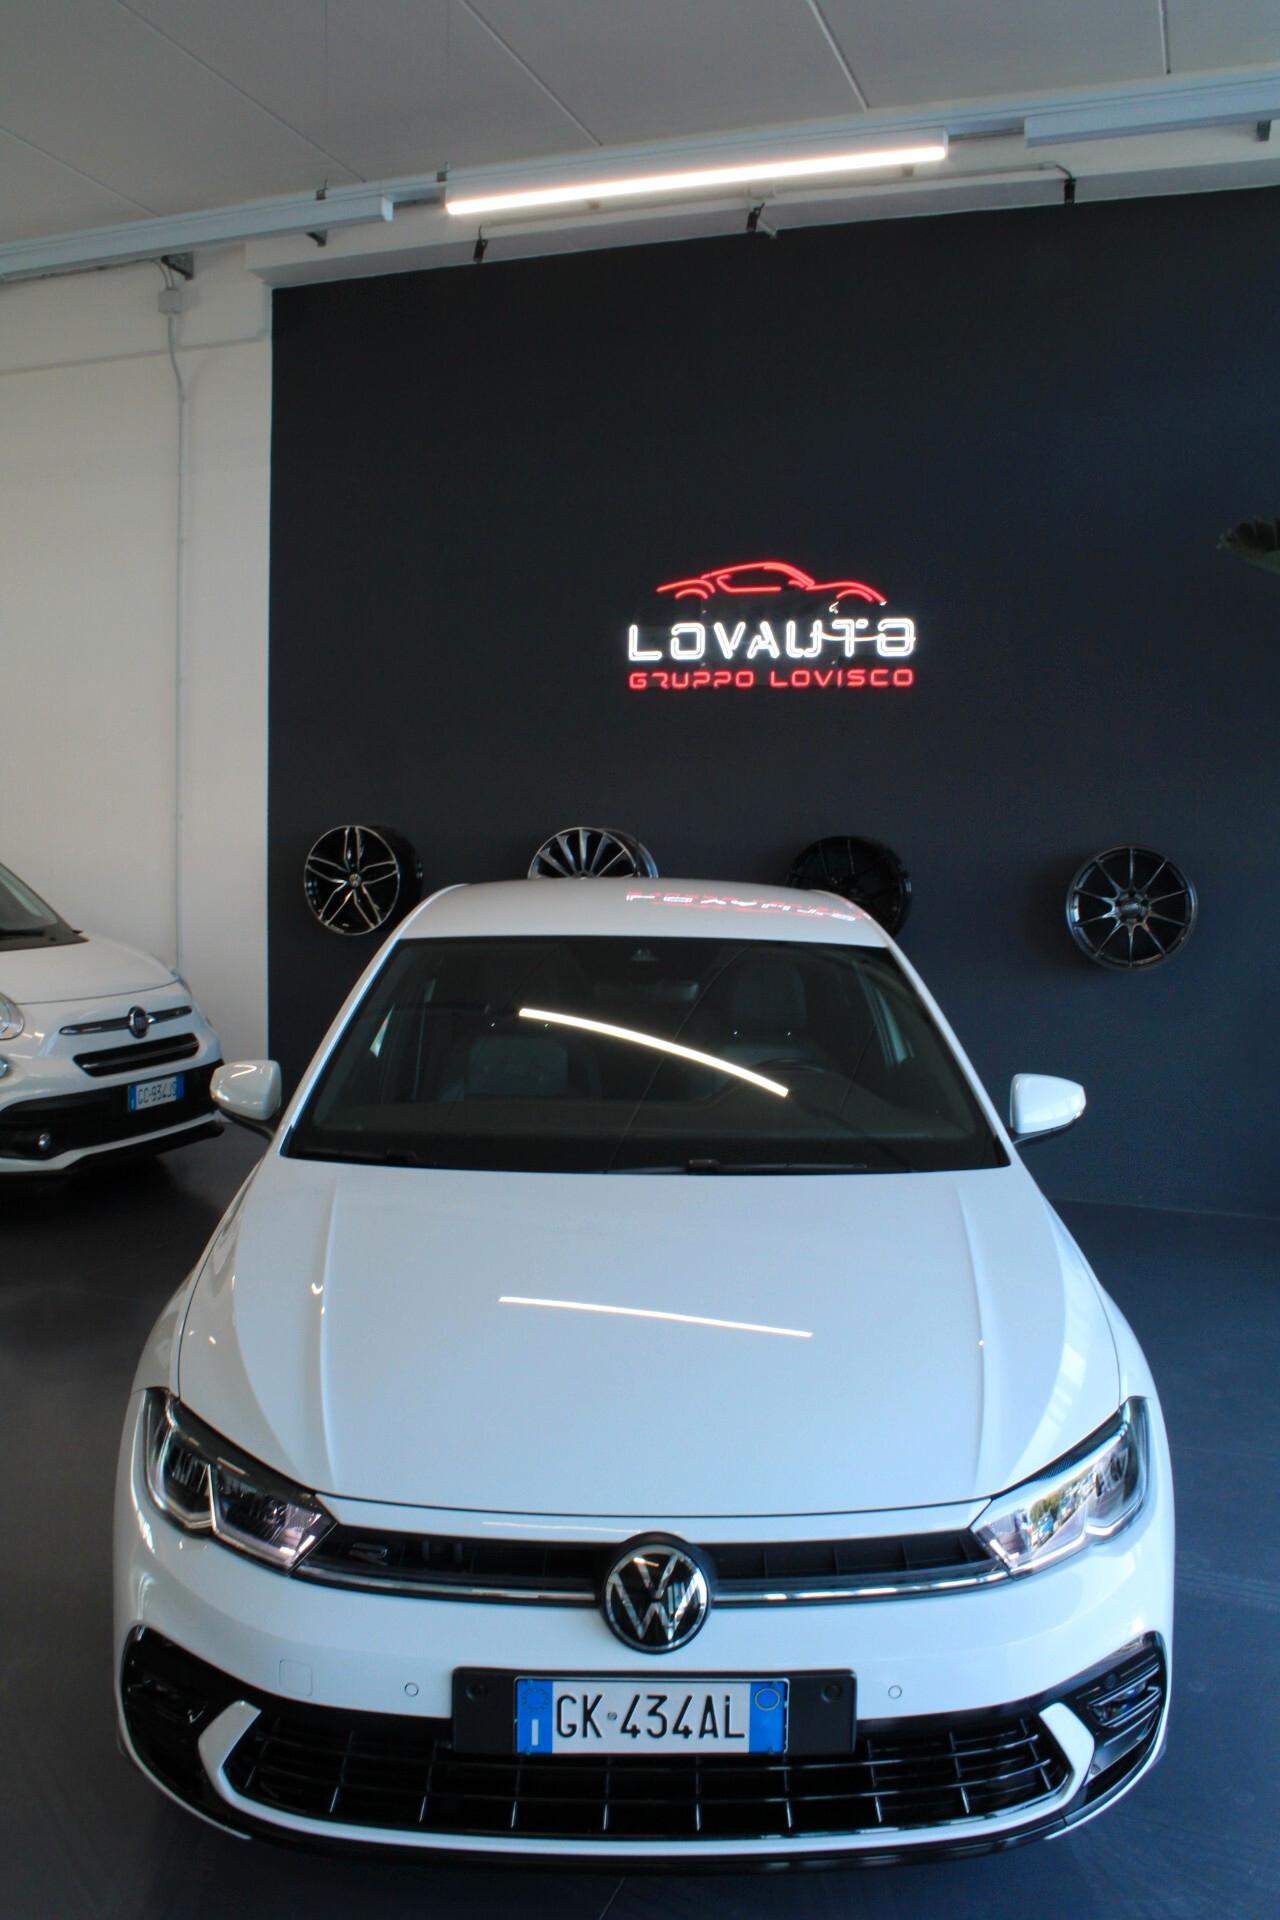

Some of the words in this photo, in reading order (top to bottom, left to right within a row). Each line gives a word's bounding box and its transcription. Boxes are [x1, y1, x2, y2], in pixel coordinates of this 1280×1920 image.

[628, 618, 916, 661] LOVAUTO
[629, 669, 755, 690] GRUPPO
[770, 668, 914, 688] LOVISCO
